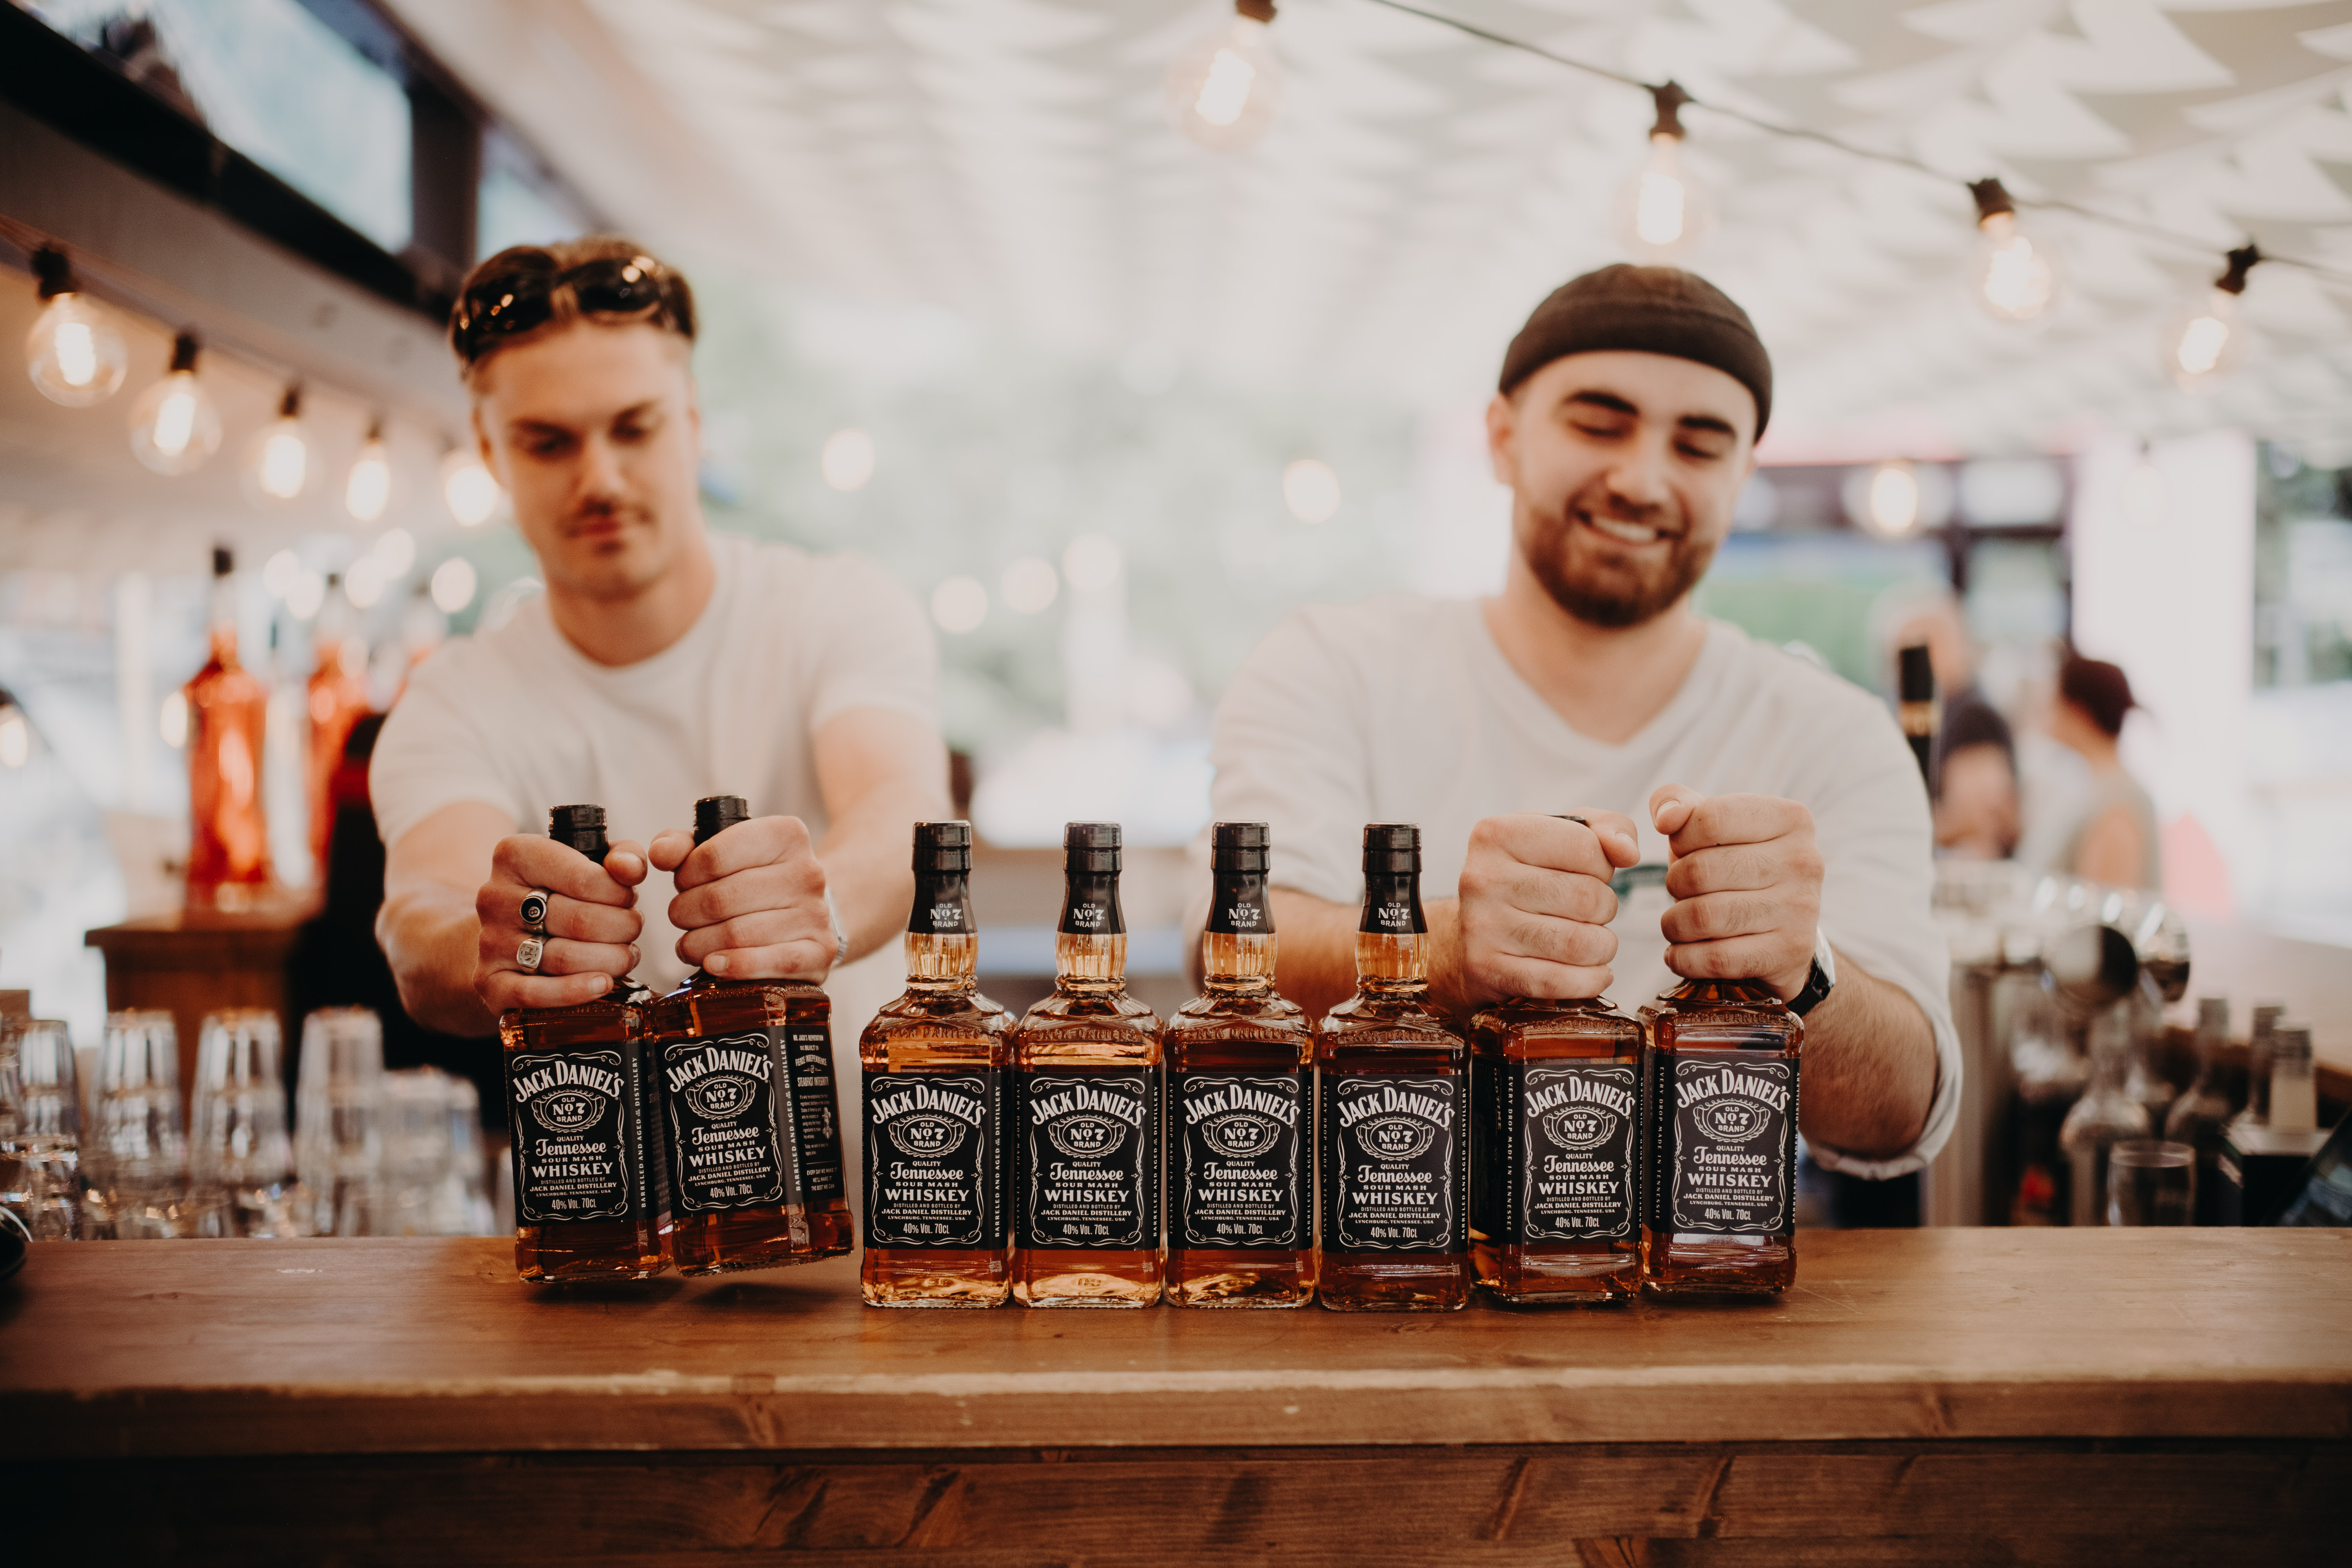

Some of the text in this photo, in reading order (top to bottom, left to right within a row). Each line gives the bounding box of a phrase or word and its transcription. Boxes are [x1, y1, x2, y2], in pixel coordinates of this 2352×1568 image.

[780, 1039, 790, 1088] DISTILLERY
[795, 1054, 827, 1066] FIERCE INDEPENDENCE
[666, 1047, 773, 1092] JACK DANIEL'S
[513, 1060, 624, 1102] JACK DANIEL'S
[797, 1076, 829, 1087] STEADFAST INTEGRITY
[728, 1087, 737, 1100] 7
[1675, 1069, 1790, 1111] JACK DANIEL'S
[1525, 1083, 1568, 1118] JACK
[1569, 1076, 1635, 1116] DANIEL'S
[575, 1102, 586, 1114] 7
[710, 1101, 735, 1111] BRAND
[871, 1084, 986, 1125] JACK DANIEL'S
[1031, 1085, 1147, 1126] JACK DANIEL'S
[1183, 1084, 1300, 1125] JACK DANIEL'S
[1337, 1093, 1383, 1128] JACK
[1384, 1087, 1454, 1128] DANIEL'S
[557, 1115, 583, 1124] BRAND
[1739, 1113, 1749, 1125] 7
[711, 1121, 737, 1130] QUALITY
[1587, 1120, 1597, 1132] 7
[1718, 1125, 1745, 1133] BRAND
[691, 1127, 760, 1145] Tennessee
[935, 1128, 945, 1140] 7
[1094, 1129, 1105, 1140] 7
[1248, 1128, 1259, 1140] 7
[1403, 1131, 1413, 1142] 7
[536, 1139, 606, 1156] Tennessee
[727, 1140, 755, 1148] MASH
[689, 1146, 766, 1167] WHISKEY
[1693, 1146, 1767, 1165] Tennessee
[532, 1162, 613, 1177] WHISKEY
[791, 1146, 801, 1191] BARRELED
[1544, 1155, 1614, 1172] Tennessee
[890, 1162, 964, 1180] Tennessee
[1050, 1163, 1123, 1180] Tennessee
[1203, 1162, 1278, 1180] Tennessee
[1357, 1165, 1432, 1183] Tennessee
[1508, 1166, 1512, 1175] IN
[1687, 1173, 1772, 1187] WHISKEY
[1538, 1181, 1619, 1194] WHISKEY
[884, 1189, 969, 1201] WHISKEY
[1044, 1190, 1129, 1202] WHISKEY
[1198, 1189, 1283, 1201] WHISKEY
[1352, 1192, 1437, 1204] WHISKEY
[552, 1199, 566, 1209] 40%
[903, 1223, 918, 1233] 40%
[1556, 1217, 1570, 1228] 40%
[1217, 1224, 1232, 1234] 40%
[1371, 1227, 1386, 1237] 40%
